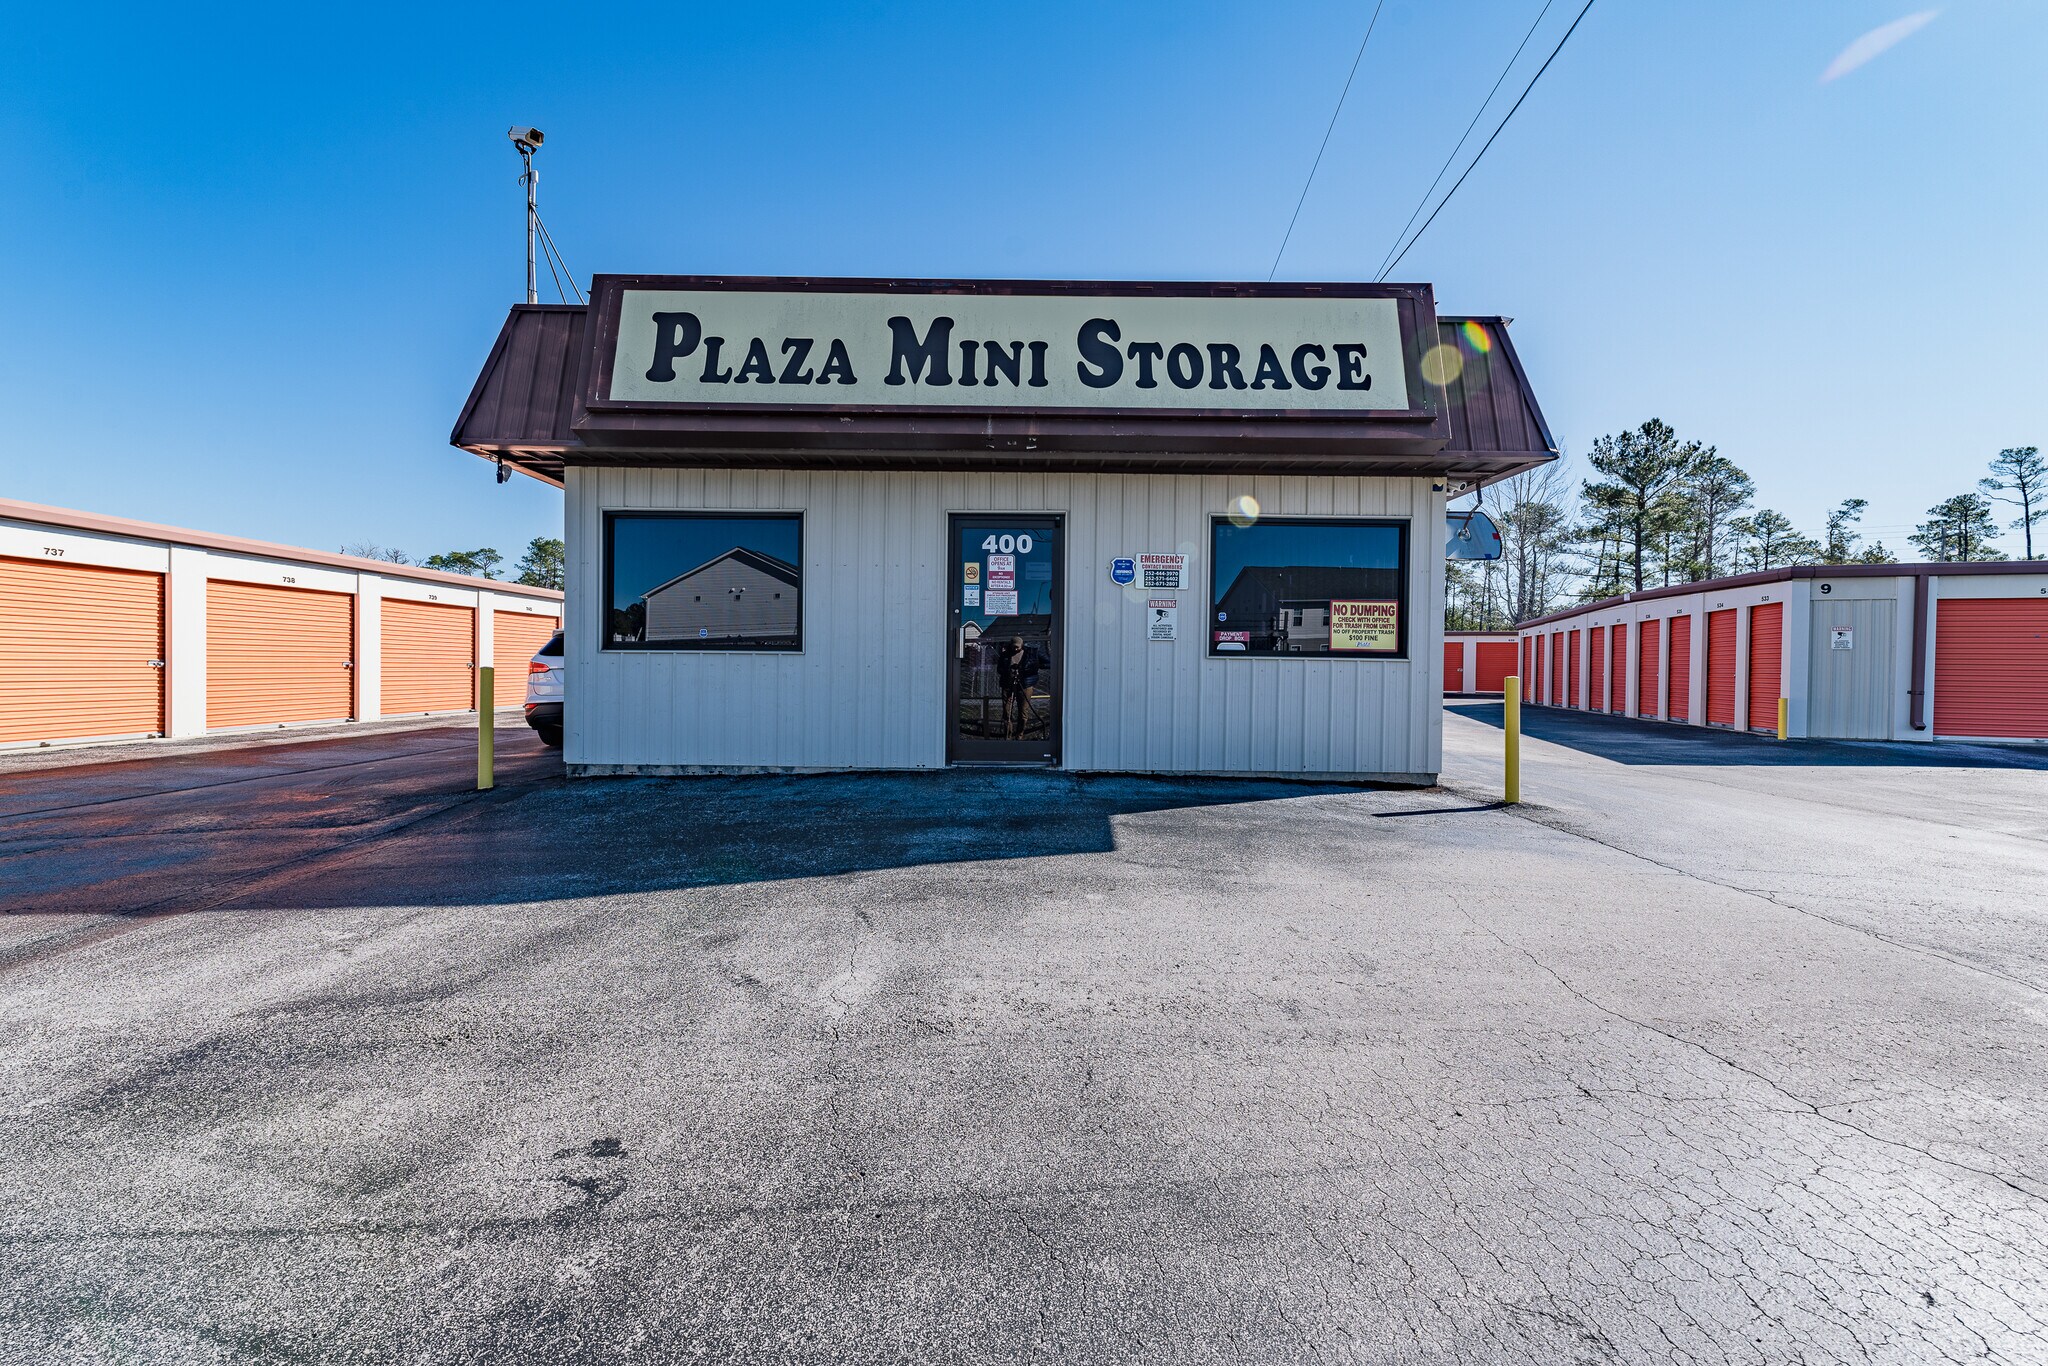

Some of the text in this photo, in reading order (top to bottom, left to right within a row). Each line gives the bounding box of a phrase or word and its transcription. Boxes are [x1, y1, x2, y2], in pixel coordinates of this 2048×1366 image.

[645, 311, 1372, 391] PLAZA MINI STORAGE
[981, 534, 1033, 554] 400
[43, 547, 65, 557] 737
[1140, 555, 1184, 564] EMERGENCY
[282, 576, 296, 584] 738
[1820, 583, 1832, 595] 9
[1333, 604, 1396, 617] NO DUMPING
